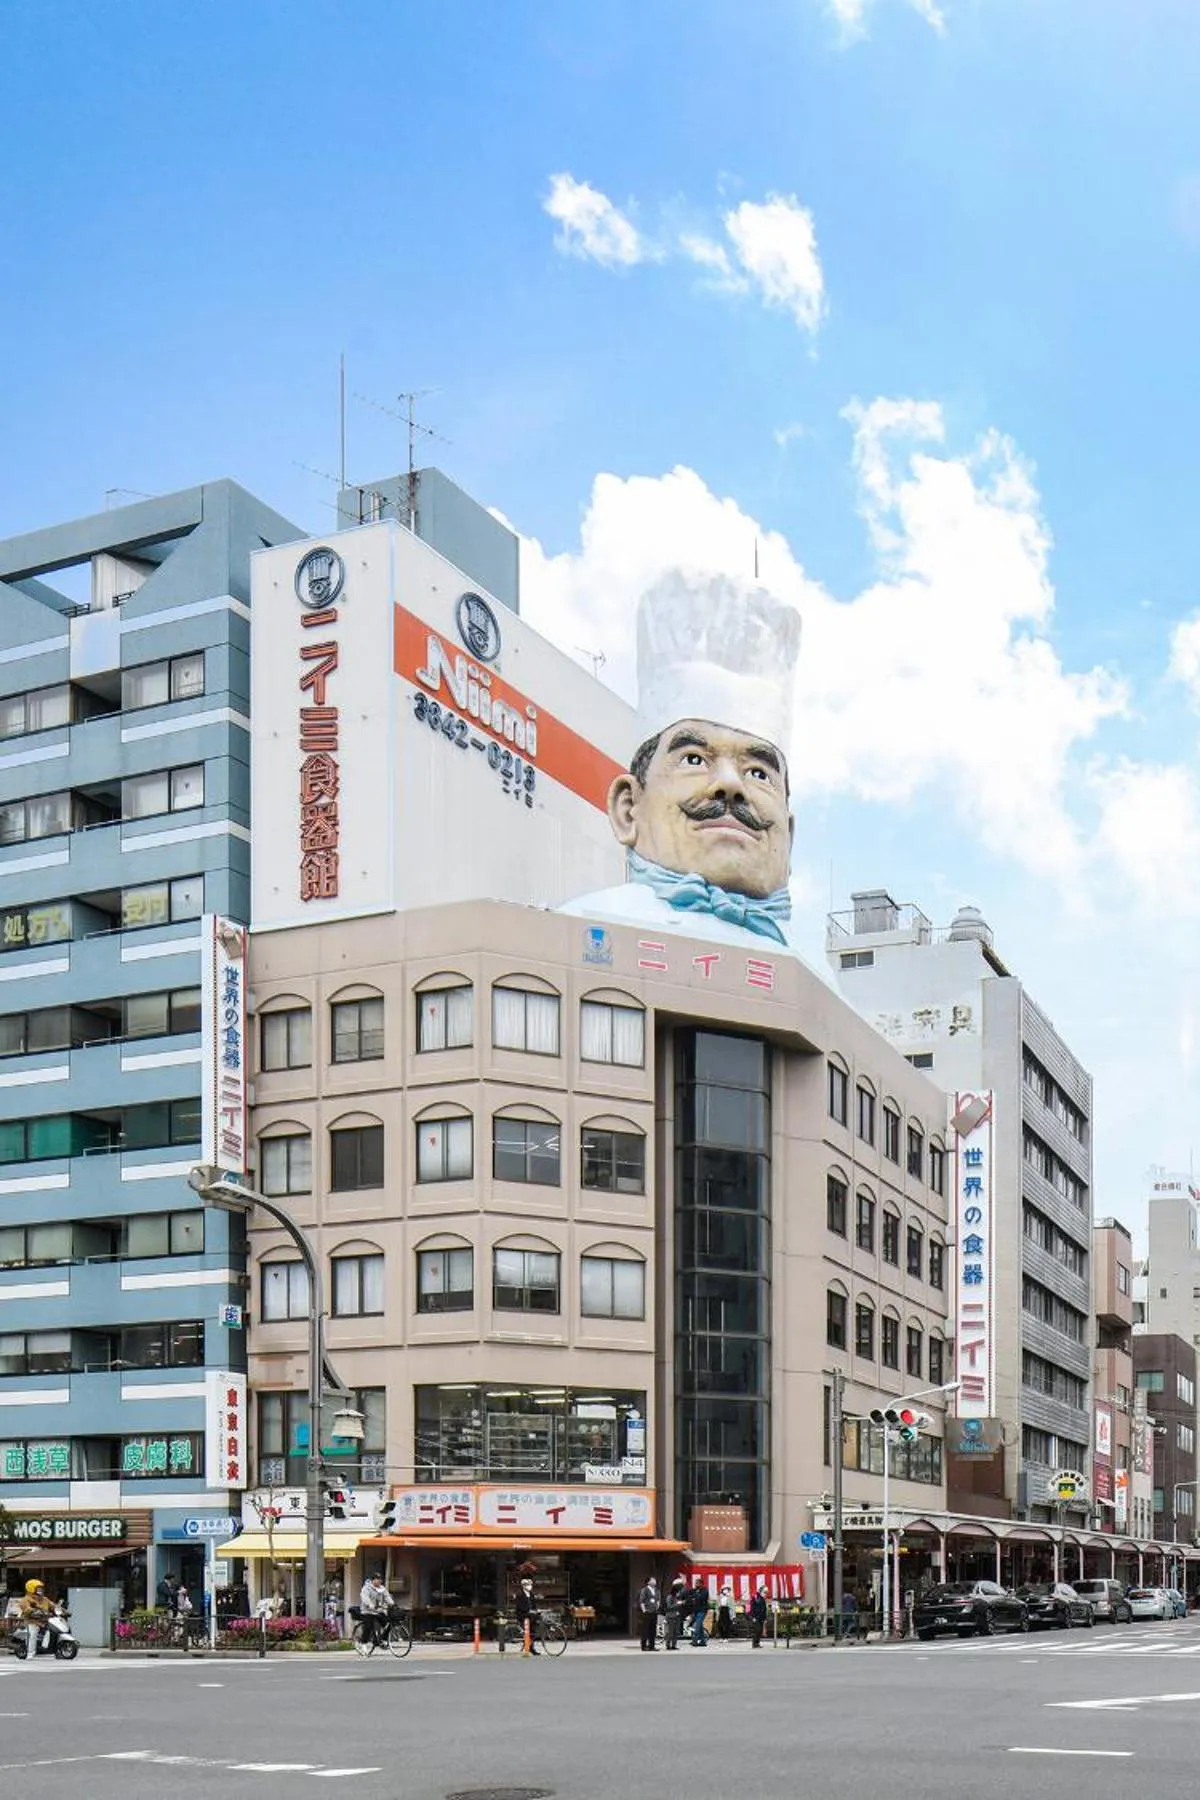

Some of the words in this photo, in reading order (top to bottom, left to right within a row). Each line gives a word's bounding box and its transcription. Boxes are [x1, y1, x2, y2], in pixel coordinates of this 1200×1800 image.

[415, 633, 537, 758] Niimi
[299, 607, 340, 903] ニイミ食器館
[638, 940, 774, 990] ニイミ
[222, 965, 241, 1071] 世界の食器
[219, 1074, 242, 1160] ニイミ
[962, 1147, 985, 1286] 世界の食器
[961, 1302, 986, 1402] ニイミ
[5, 1445, 71, 1475] 西浅草
[122, 1438, 193, 1472] 皮膚科
[14, 1519, 51, 1539] MOS
[54, 1519, 122, 1538] BURGER
[418, 1504, 470, 1524] ニイミ
[496, 1505, 614, 1525] ニイミ
